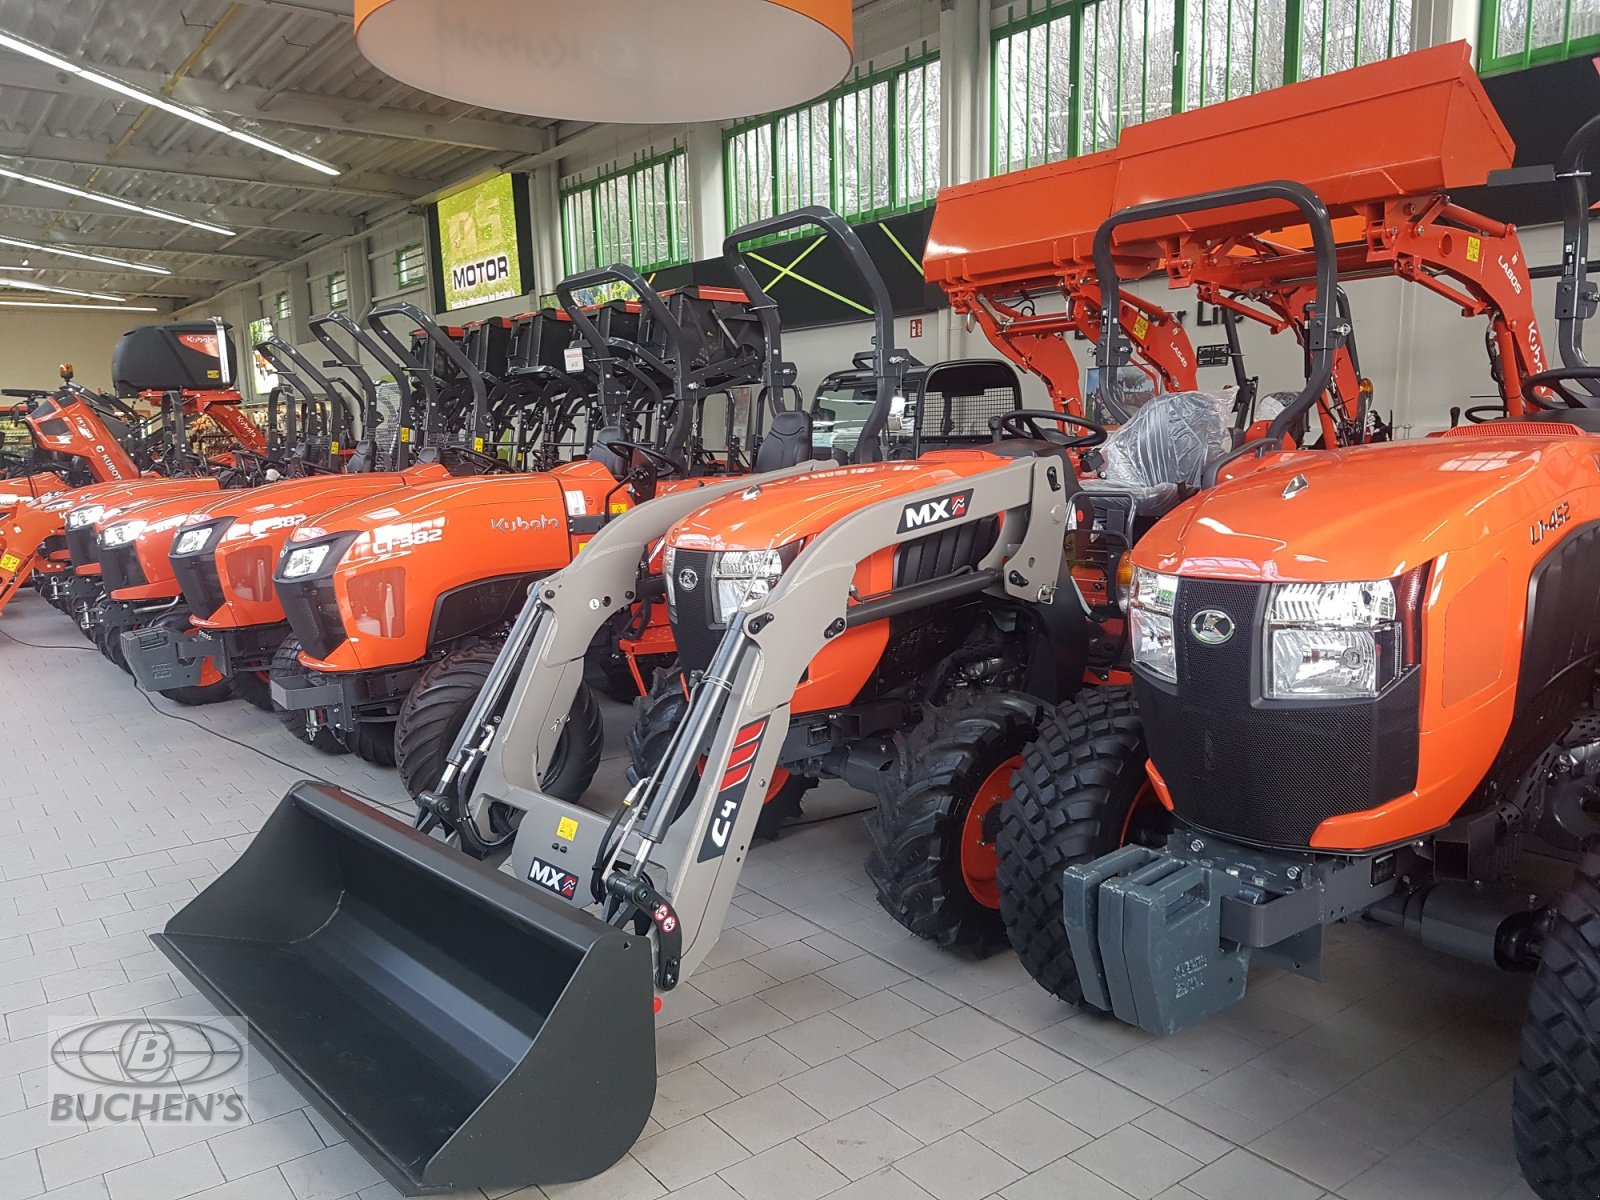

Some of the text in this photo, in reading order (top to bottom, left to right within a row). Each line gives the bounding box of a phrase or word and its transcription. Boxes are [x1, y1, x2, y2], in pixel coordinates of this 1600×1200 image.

[453, 256, 508, 290] MOTOR
[237, 415, 257, 438] Kubota
[101, 453, 123, 480] KUBOT
[490, 513, 560, 532] Kubota
[905, 498, 951, 528] MX
[529, 860, 565, 891] MX
